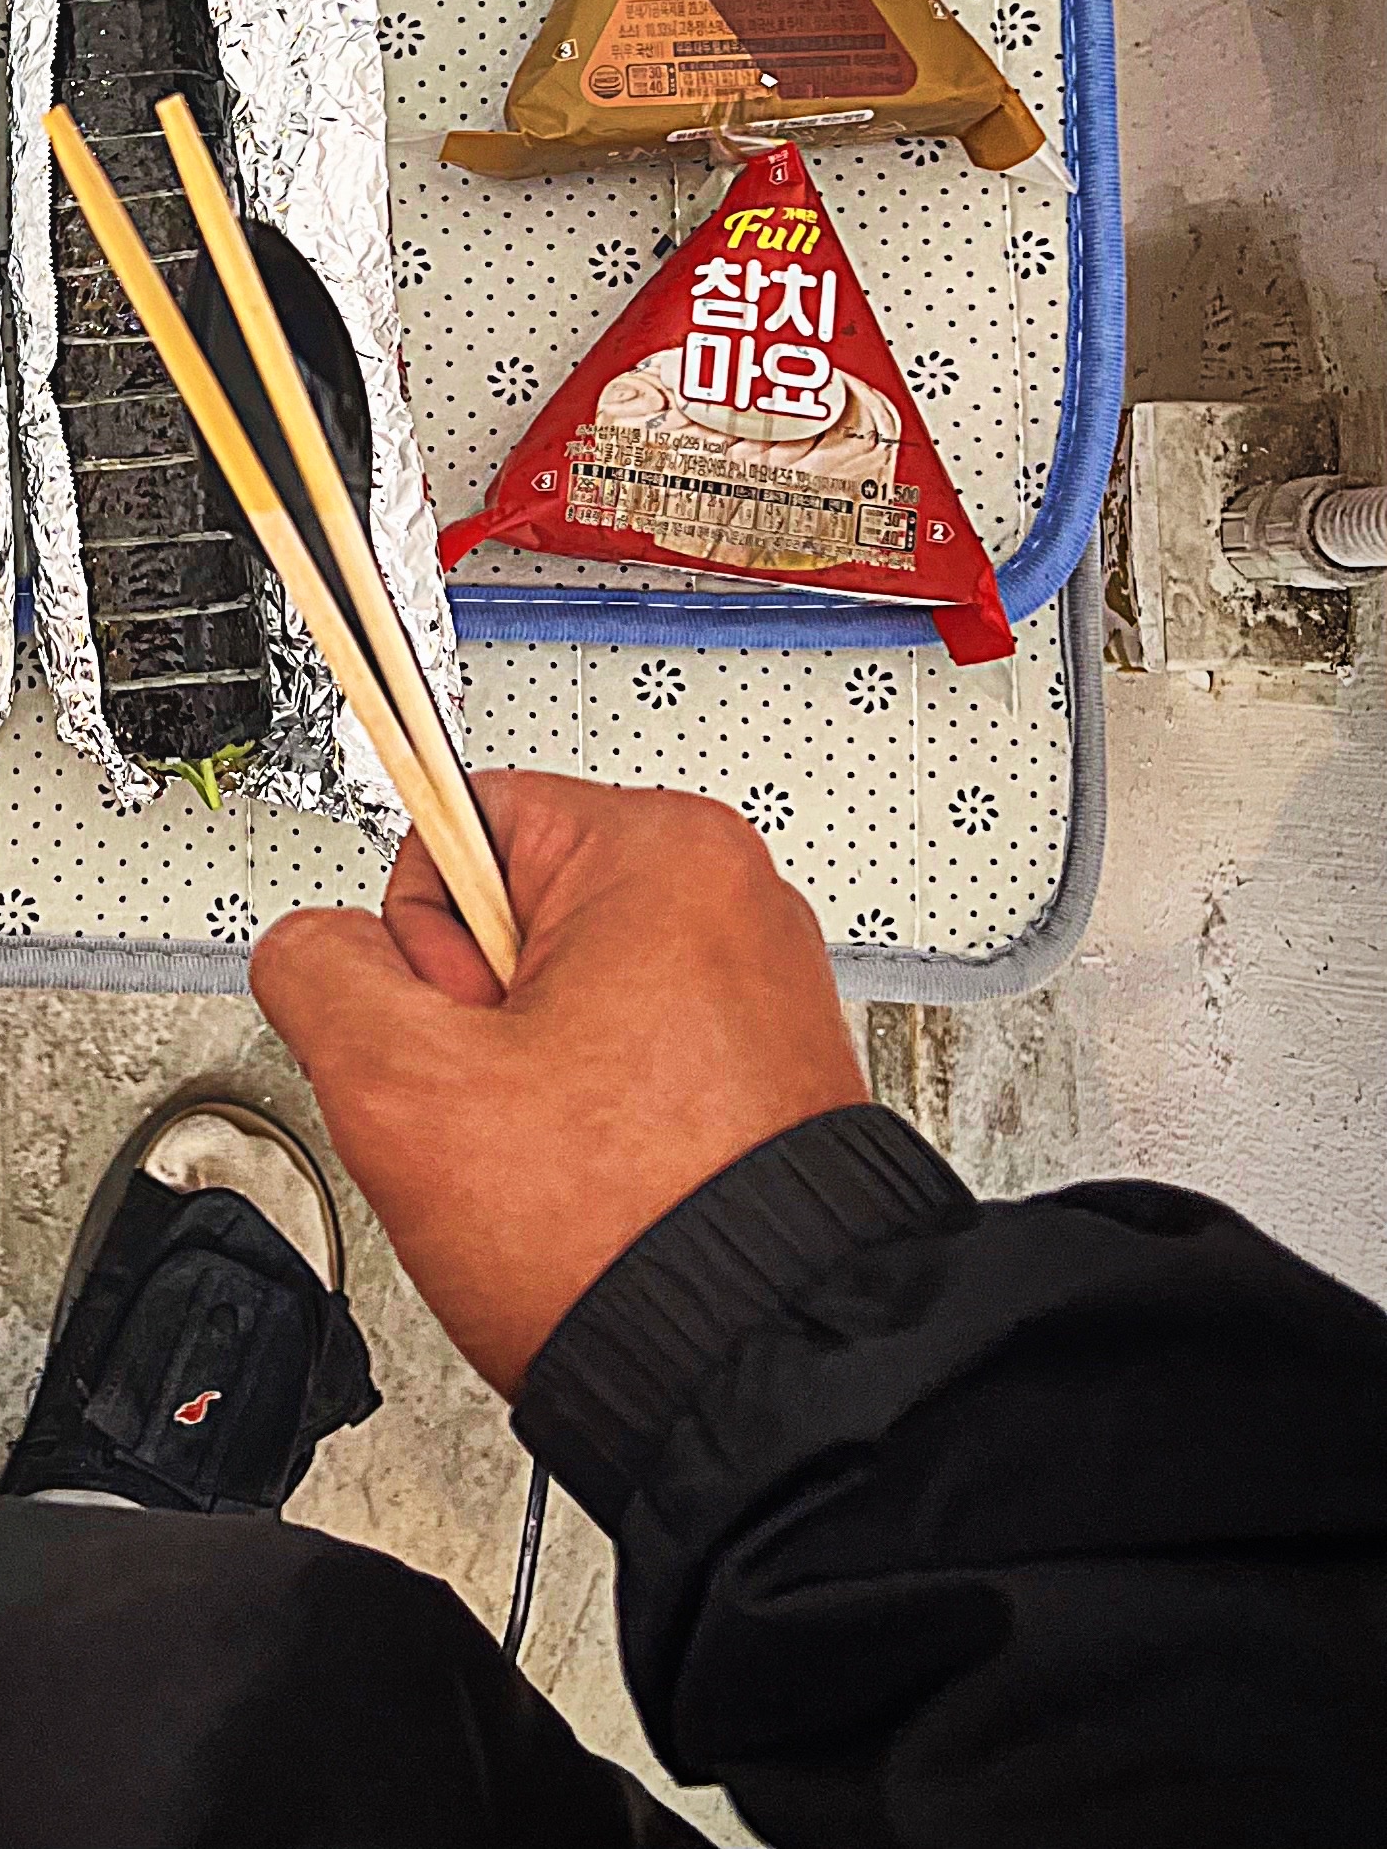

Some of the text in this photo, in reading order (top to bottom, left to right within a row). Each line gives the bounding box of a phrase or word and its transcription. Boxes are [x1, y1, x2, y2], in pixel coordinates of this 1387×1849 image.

[560, 43, 572, 58] 3
[775, 168, 784, 181] 1
[724, 207, 821, 254] Full
[690, 256, 837, 343] 참치
[682, 331, 831, 418] 마요
[541, 474, 552, 489] 3
[933, 524, 944, 540] 2
